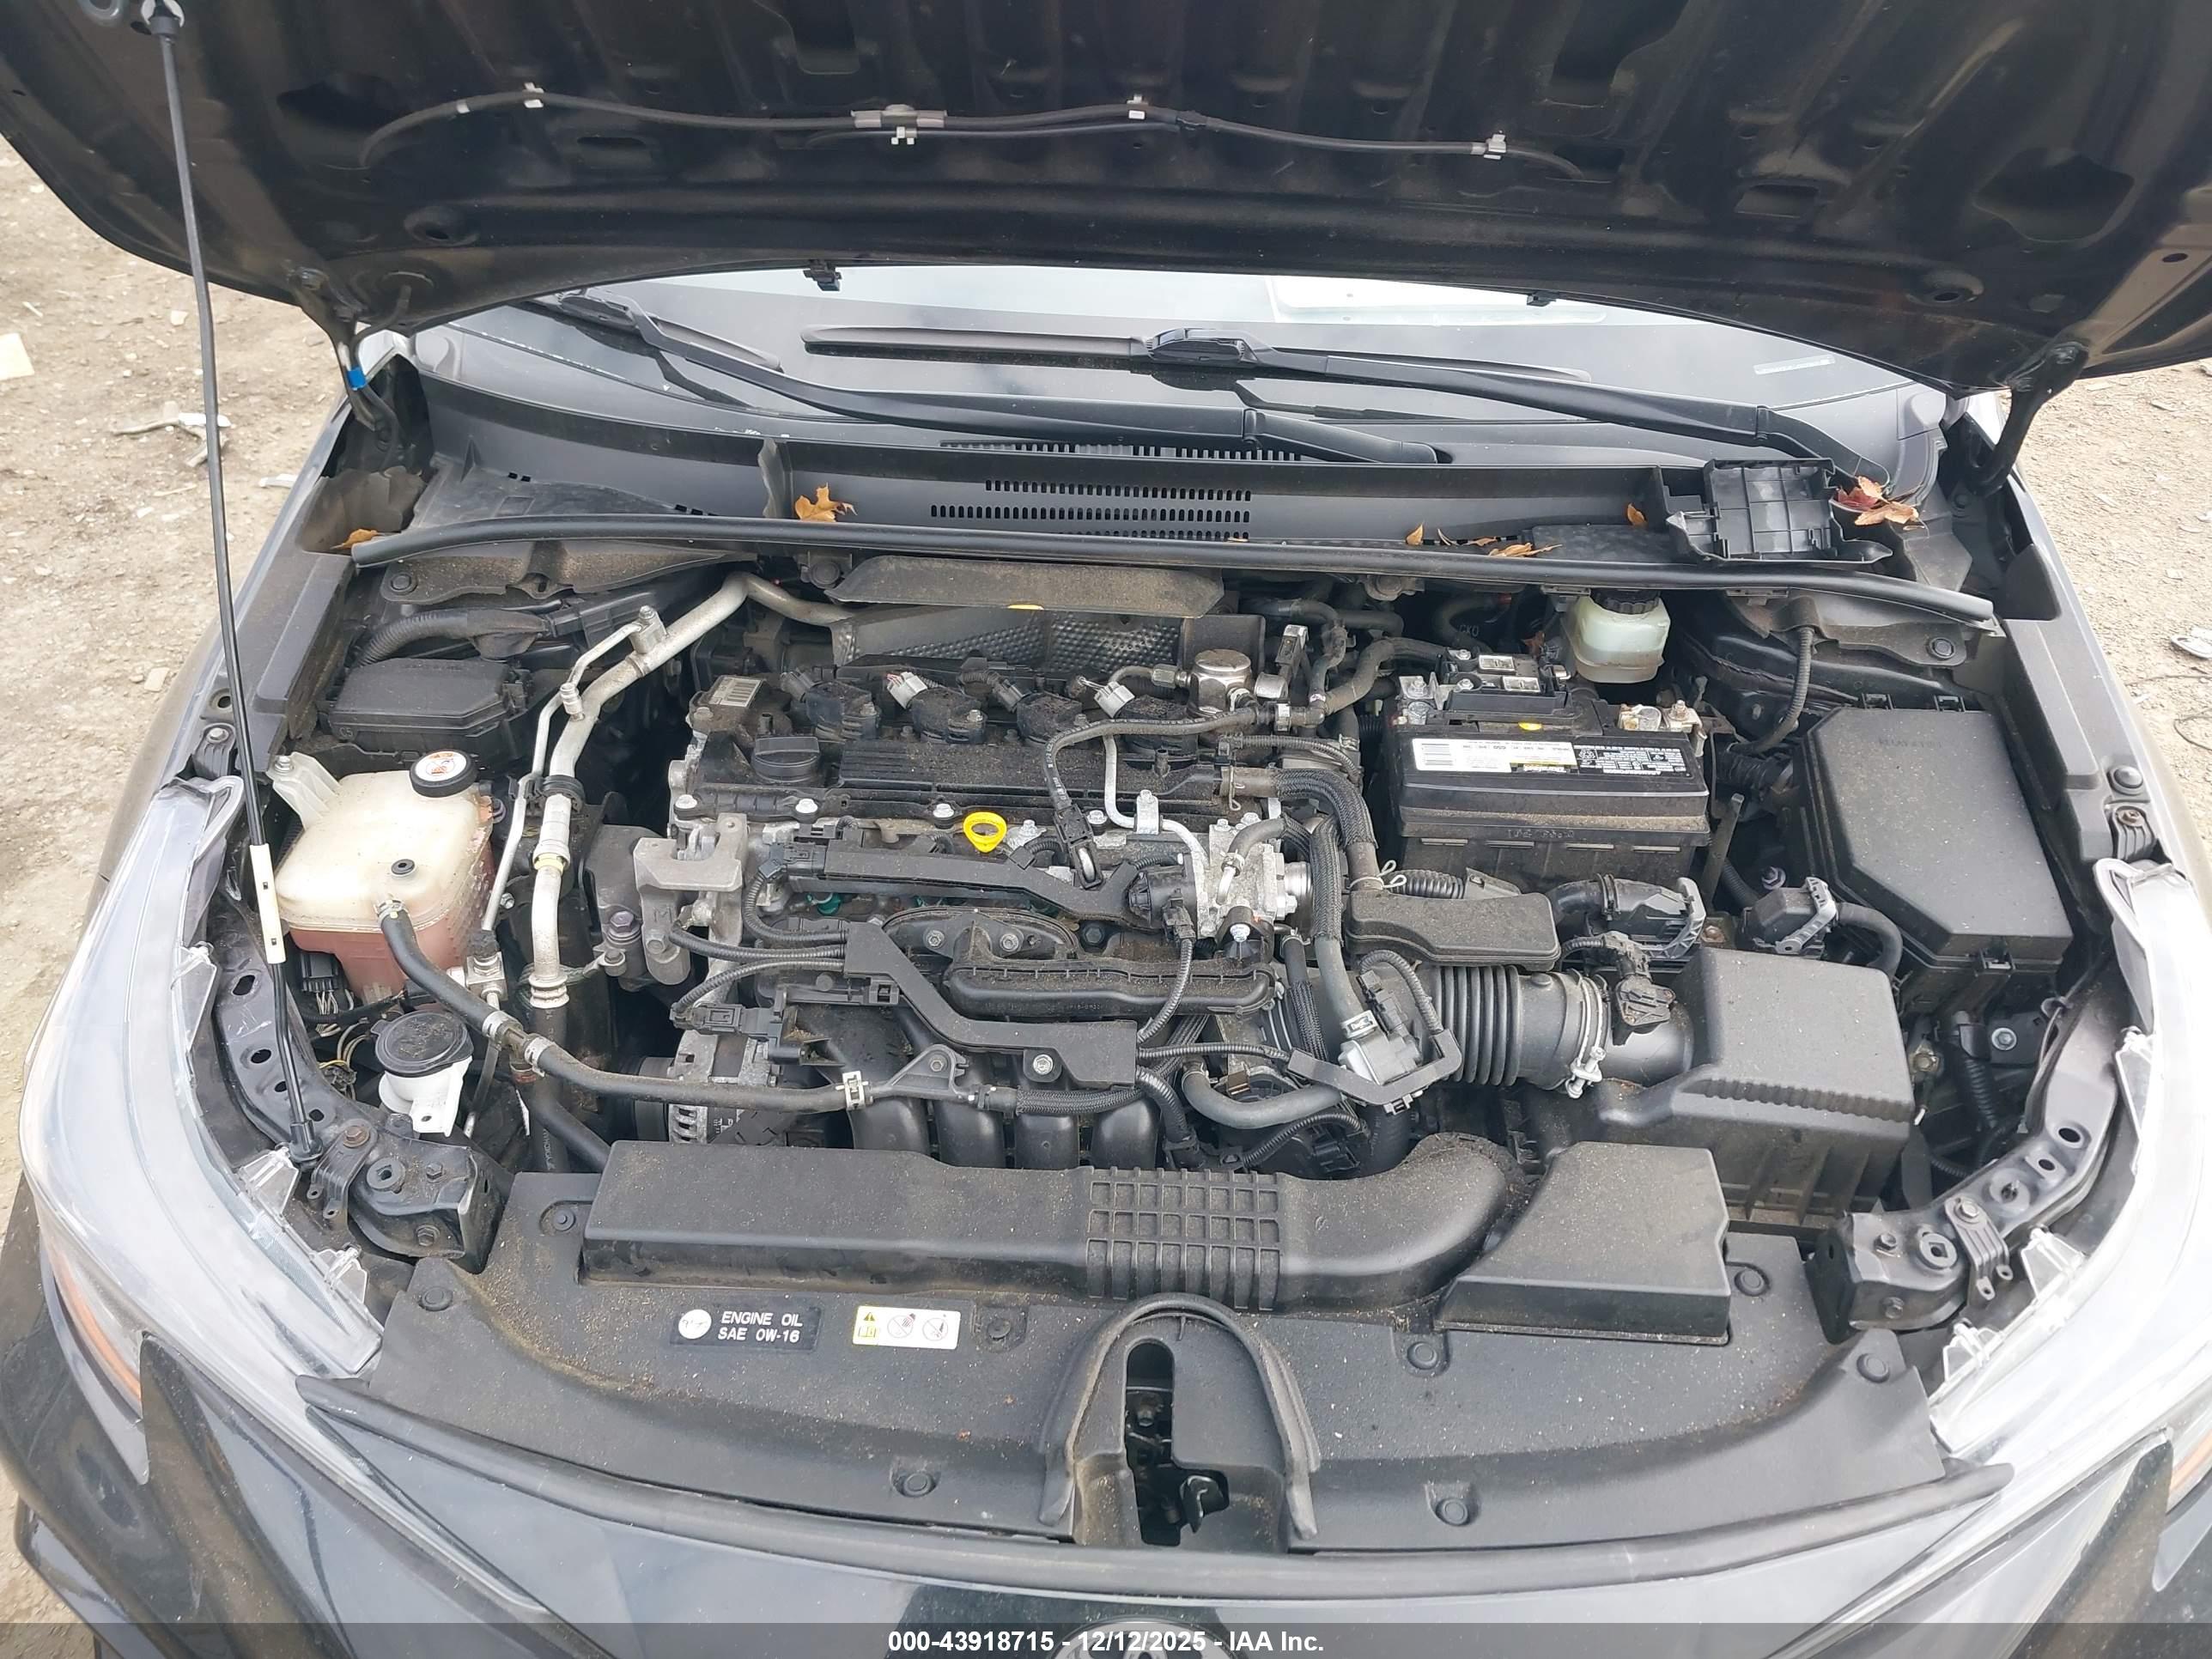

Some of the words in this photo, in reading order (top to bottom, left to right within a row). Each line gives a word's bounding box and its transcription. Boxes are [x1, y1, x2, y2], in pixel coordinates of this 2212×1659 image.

[720, 1310, 774, 1326] ENGINE
[781, 1313, 804, 1328] OIL
[717, 1326, 748, 1341] SAE
[756, 1328, 800, 1343] 0W-16
